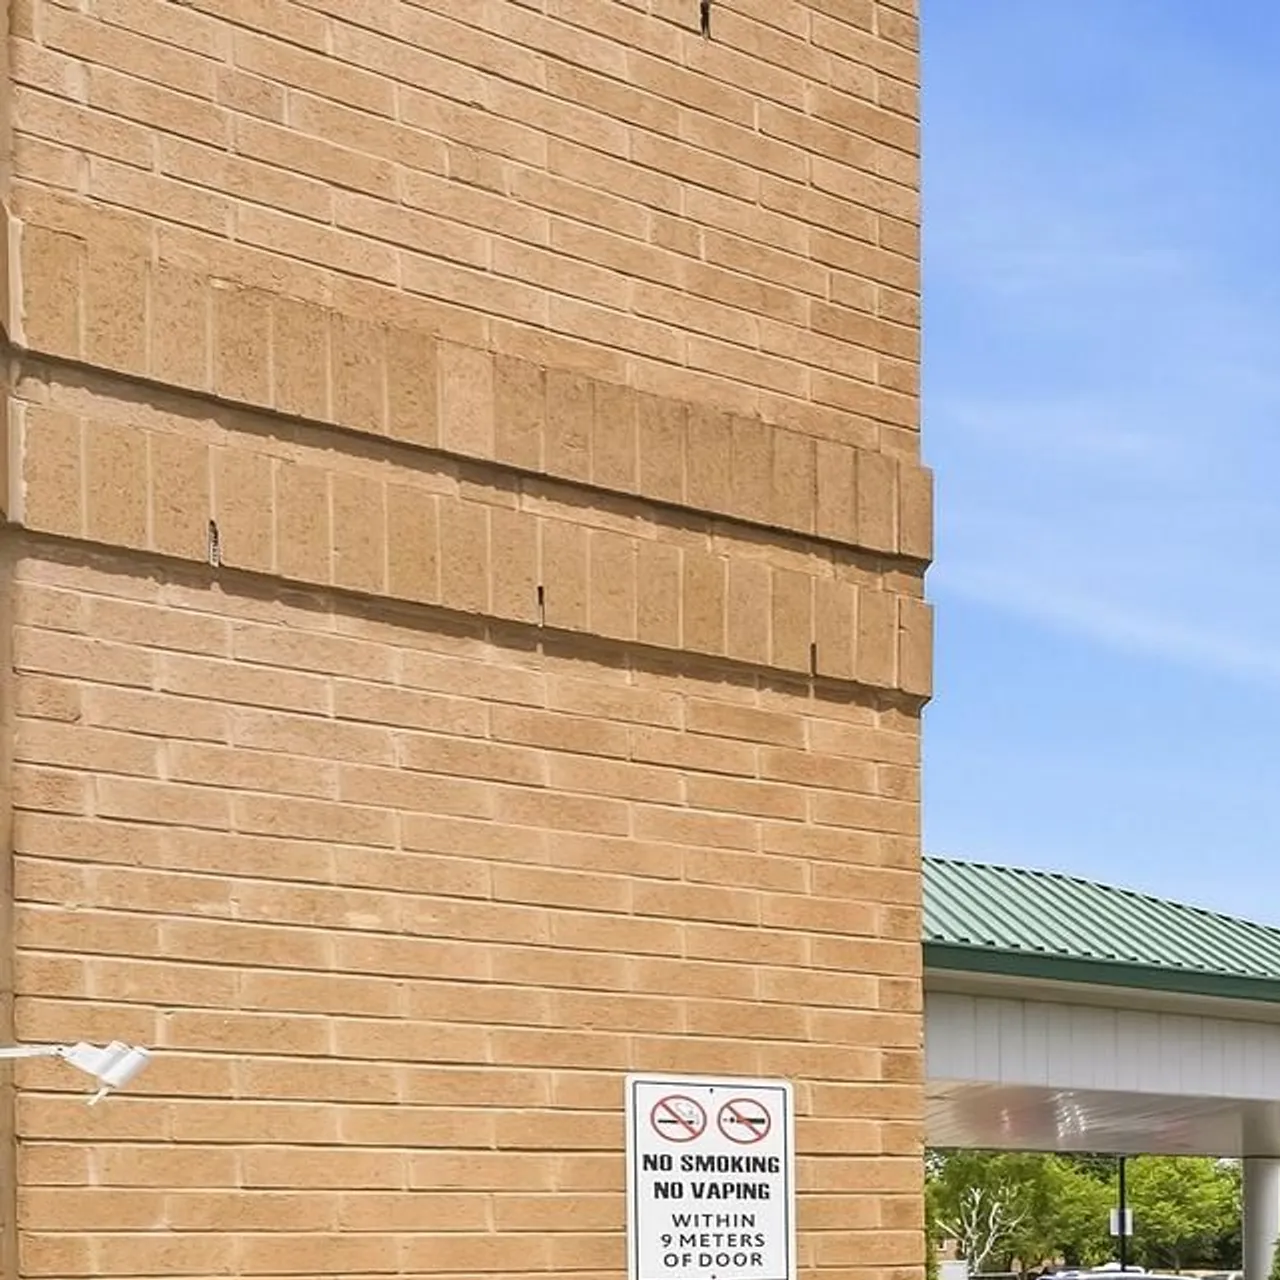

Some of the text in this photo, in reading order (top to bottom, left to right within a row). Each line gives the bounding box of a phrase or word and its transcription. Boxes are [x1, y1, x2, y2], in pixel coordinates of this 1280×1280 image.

[642, 1154, 780, 1174] NO SMOKING
[653, 1181, 771, 1200] NO VAPING
[672, 1214, 756, 1228] WITHIN
[660, 1233, 765, 1248] 9 METERS
[663, 1252, 764, 1268] OF DOOR
